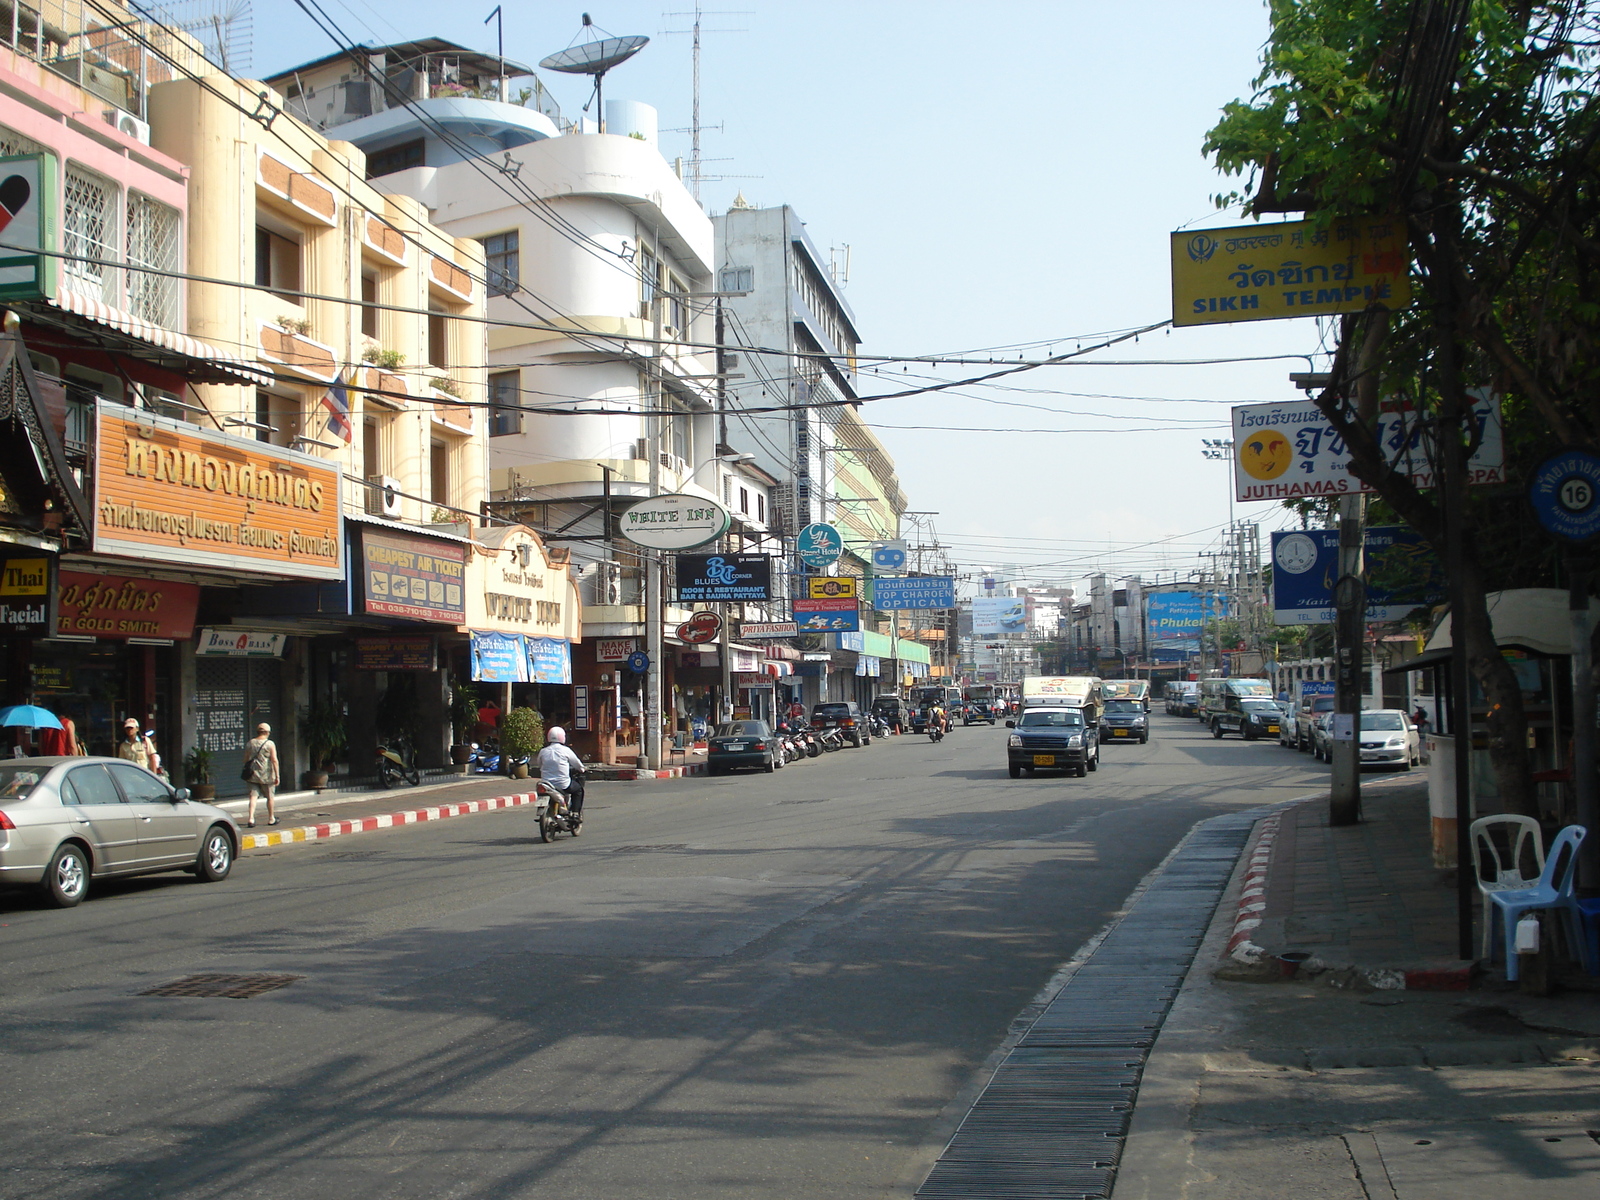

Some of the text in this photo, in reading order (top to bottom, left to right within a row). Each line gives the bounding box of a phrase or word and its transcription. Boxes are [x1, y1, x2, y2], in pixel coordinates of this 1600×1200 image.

[1193, 283, 1392, 314] SIKH TEMPLE
[1242, 479, 1348, 499] JUTHAMAS
[1565, 486, 1587, 503] 16
[628, 507, 716, 524] WHITE INN
[821, 547, 840, 556] Hotel
[367, 545, 414, 569] CHEAPEST
[418, 555, 433, 572] AIR
[434, 558, 462, 577] TICKET
[6, 568, 43, 587] Thai
[902, 590, 951, 598] CHAROEN
[1297, 598, 1330, 606] Hair
[371, 602, 385, 611] Tel.
[388, 604, 432, 617] 038-710153
[439, 611, 462, 620] 710154
[484, 591, 532, 622] WHITE
[536, 600, 561, 625] INN
[821, 604, 840, 612] Training
[882, 599, 947, 608] OPTICAL
[0, 604, 45, 624] Facial
[76, 617, 114, 631] GOLD
[119, 620, 160, 634] SMITH
[765, 624, 796, 633] FASHION
[602, 640, 631, 650] MAKE
[209, 711, 244, 730] SERVICE
